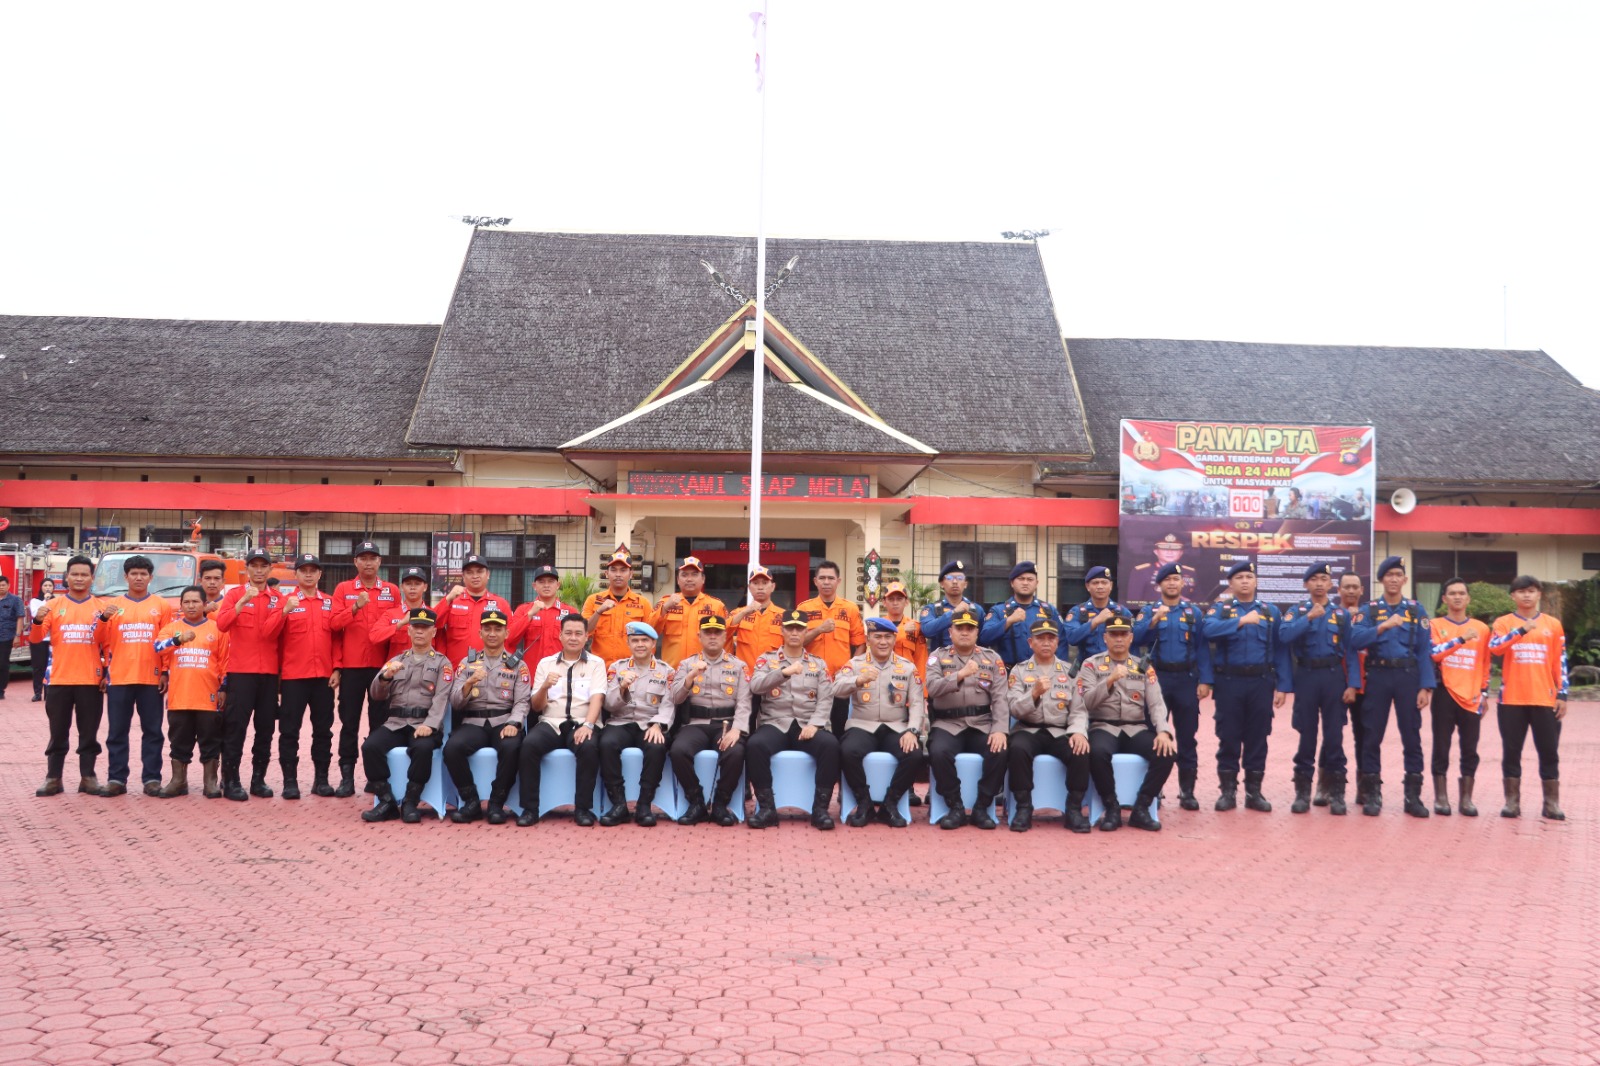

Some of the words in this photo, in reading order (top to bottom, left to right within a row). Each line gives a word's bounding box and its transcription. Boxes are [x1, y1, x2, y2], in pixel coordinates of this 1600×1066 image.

[1177, 424, 1318, 454] PAMAPTA
[1228, 455, 1273, 463] TERDEPAN
[1205, 465, 1241, 476] SIAGA
[1245, 466, 1261, 476] 24
[1264, 467, 1291, 477] JAM
[678, 475, 726, 494] KAMI
[808, 477, 868, 496] MELA
[1203, 477, 1233, 486] UNTUK
[1236, 478, 1292, 487] MASYARAKAT
[1233, 497, 1260, 512] 110
[1191, 531, 1293, 550] RESPEK
[437, 540, 471, 558] STOP
